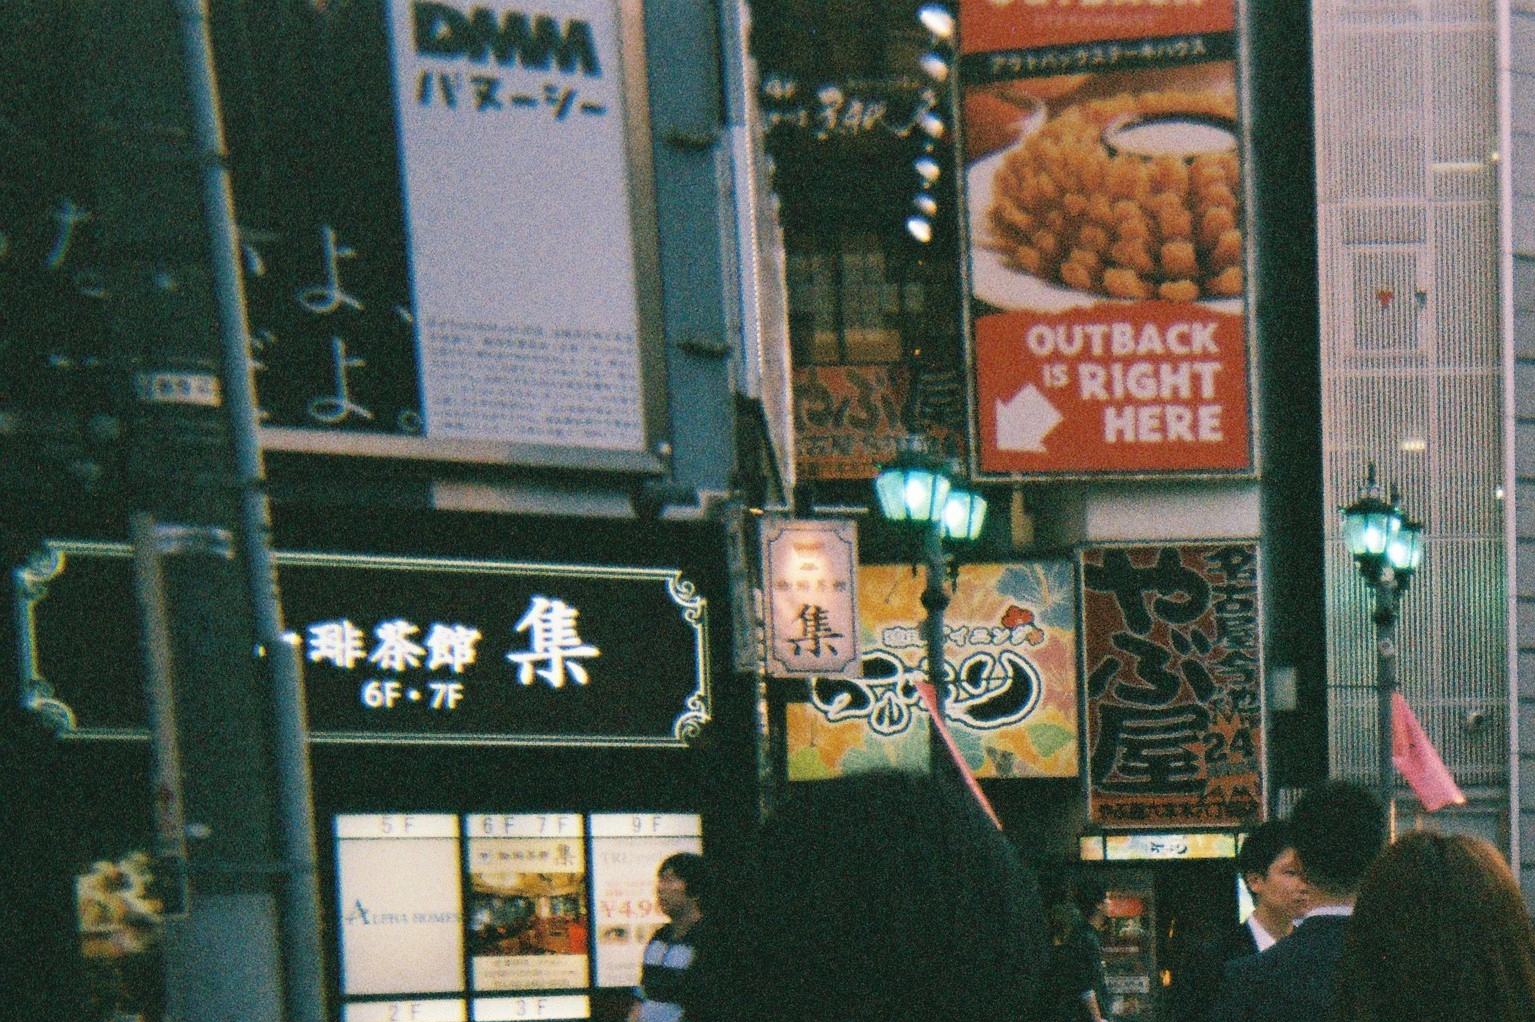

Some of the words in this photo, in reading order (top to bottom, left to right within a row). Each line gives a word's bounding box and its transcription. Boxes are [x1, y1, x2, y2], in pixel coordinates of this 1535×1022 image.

[415, 3, 603, 78] DMM
[1026, 322, 1220, 357] OUTBACK
[1041, 363, 1069, 388] IS
[1078, 361, 1222, 401] RIGHT
[1104, 404, 1224, 443] HERE
[280, 619, 482, 673] 琲茶館
[505, 596, 601, 688] 集
[787, 604, 843, 656] 集
[1084, 547, 1217, 795] やぶ屋
